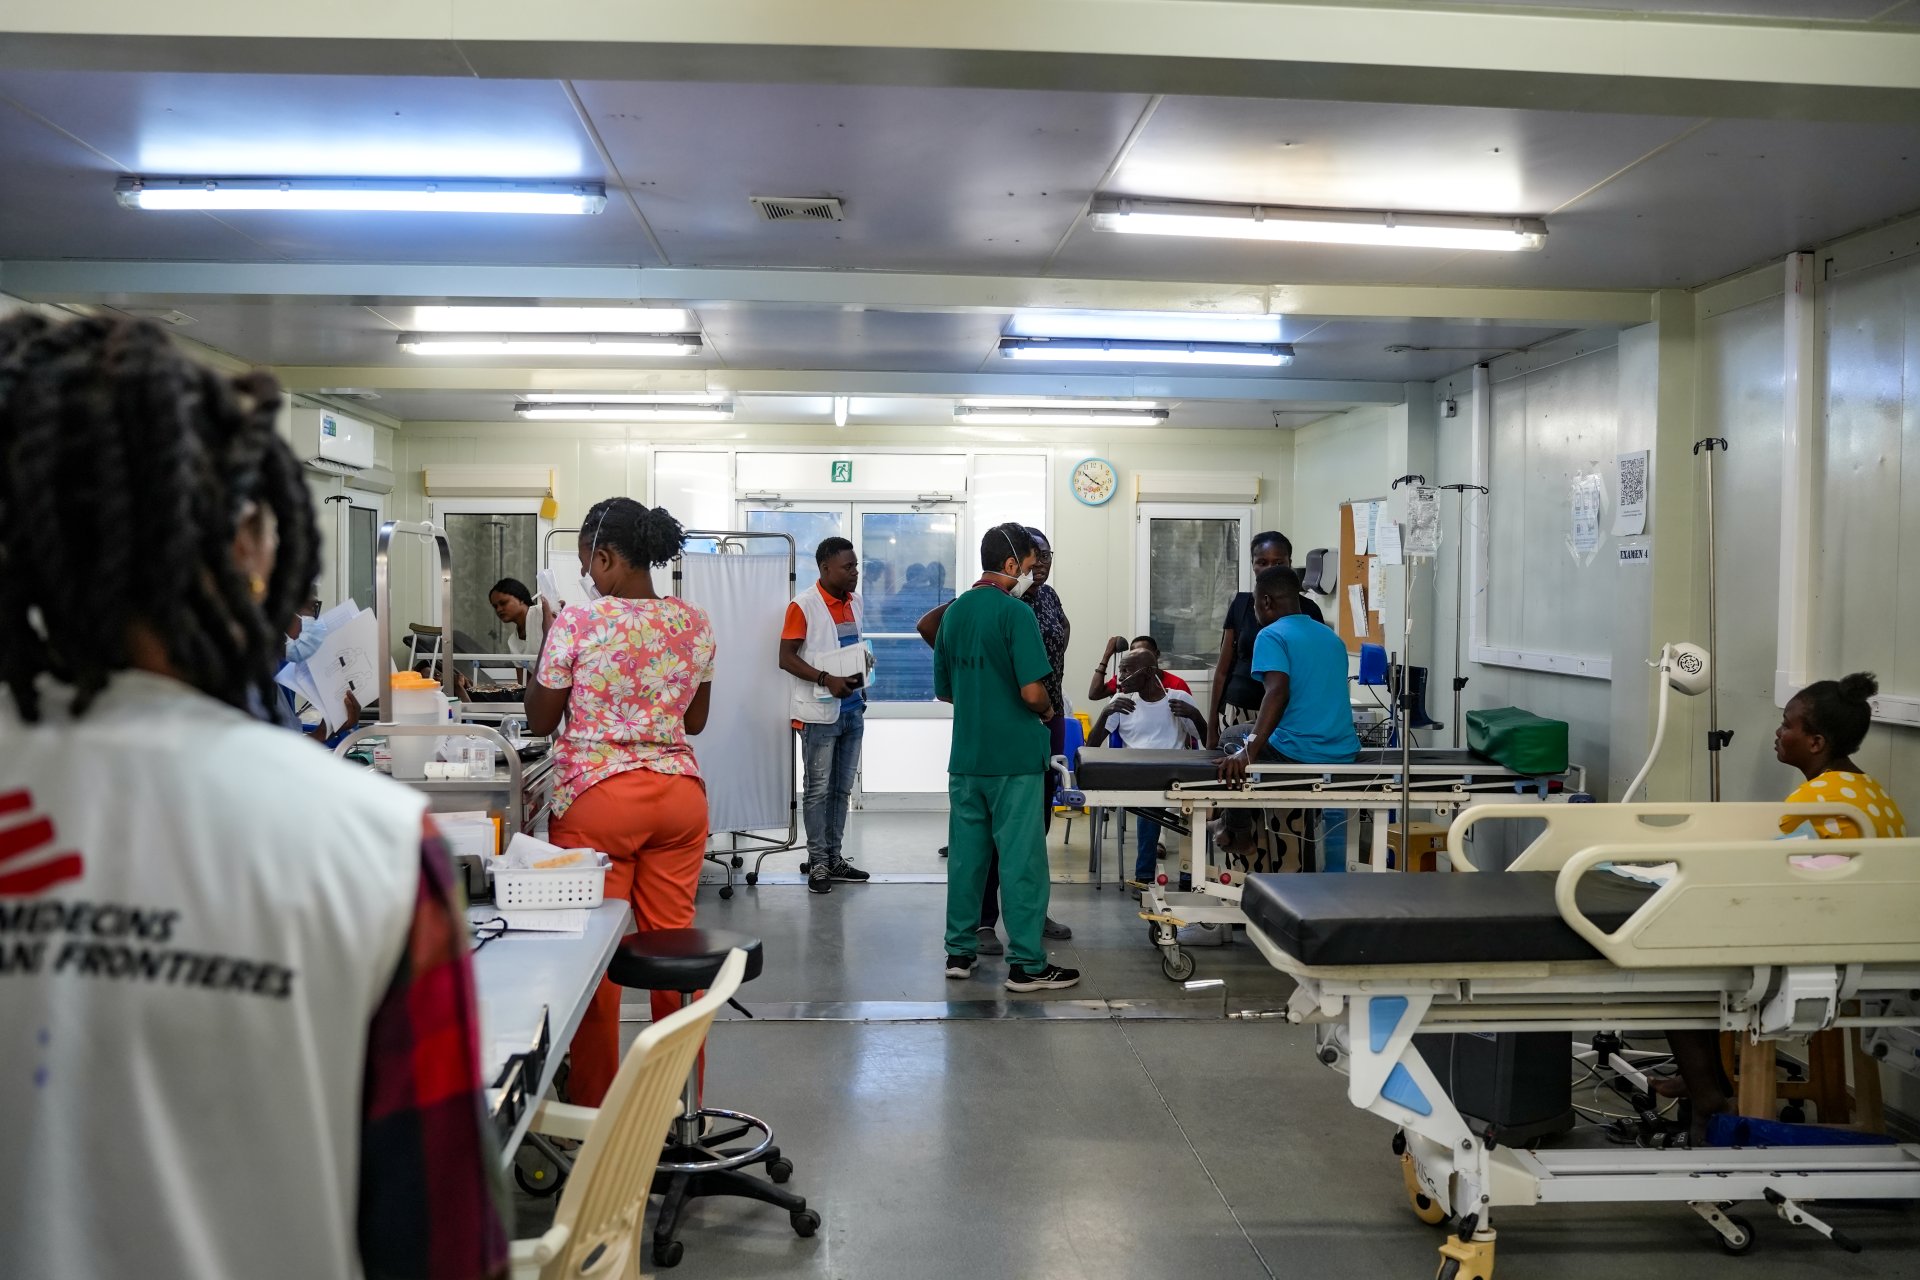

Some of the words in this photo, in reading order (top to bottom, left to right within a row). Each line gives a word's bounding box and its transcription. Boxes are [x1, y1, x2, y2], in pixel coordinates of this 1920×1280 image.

[1620, 549, 1643, 560] EXAMEN
[1644, 549, 1649, 559] 4
[54, 943, 294, 1000] FRONTIERES
